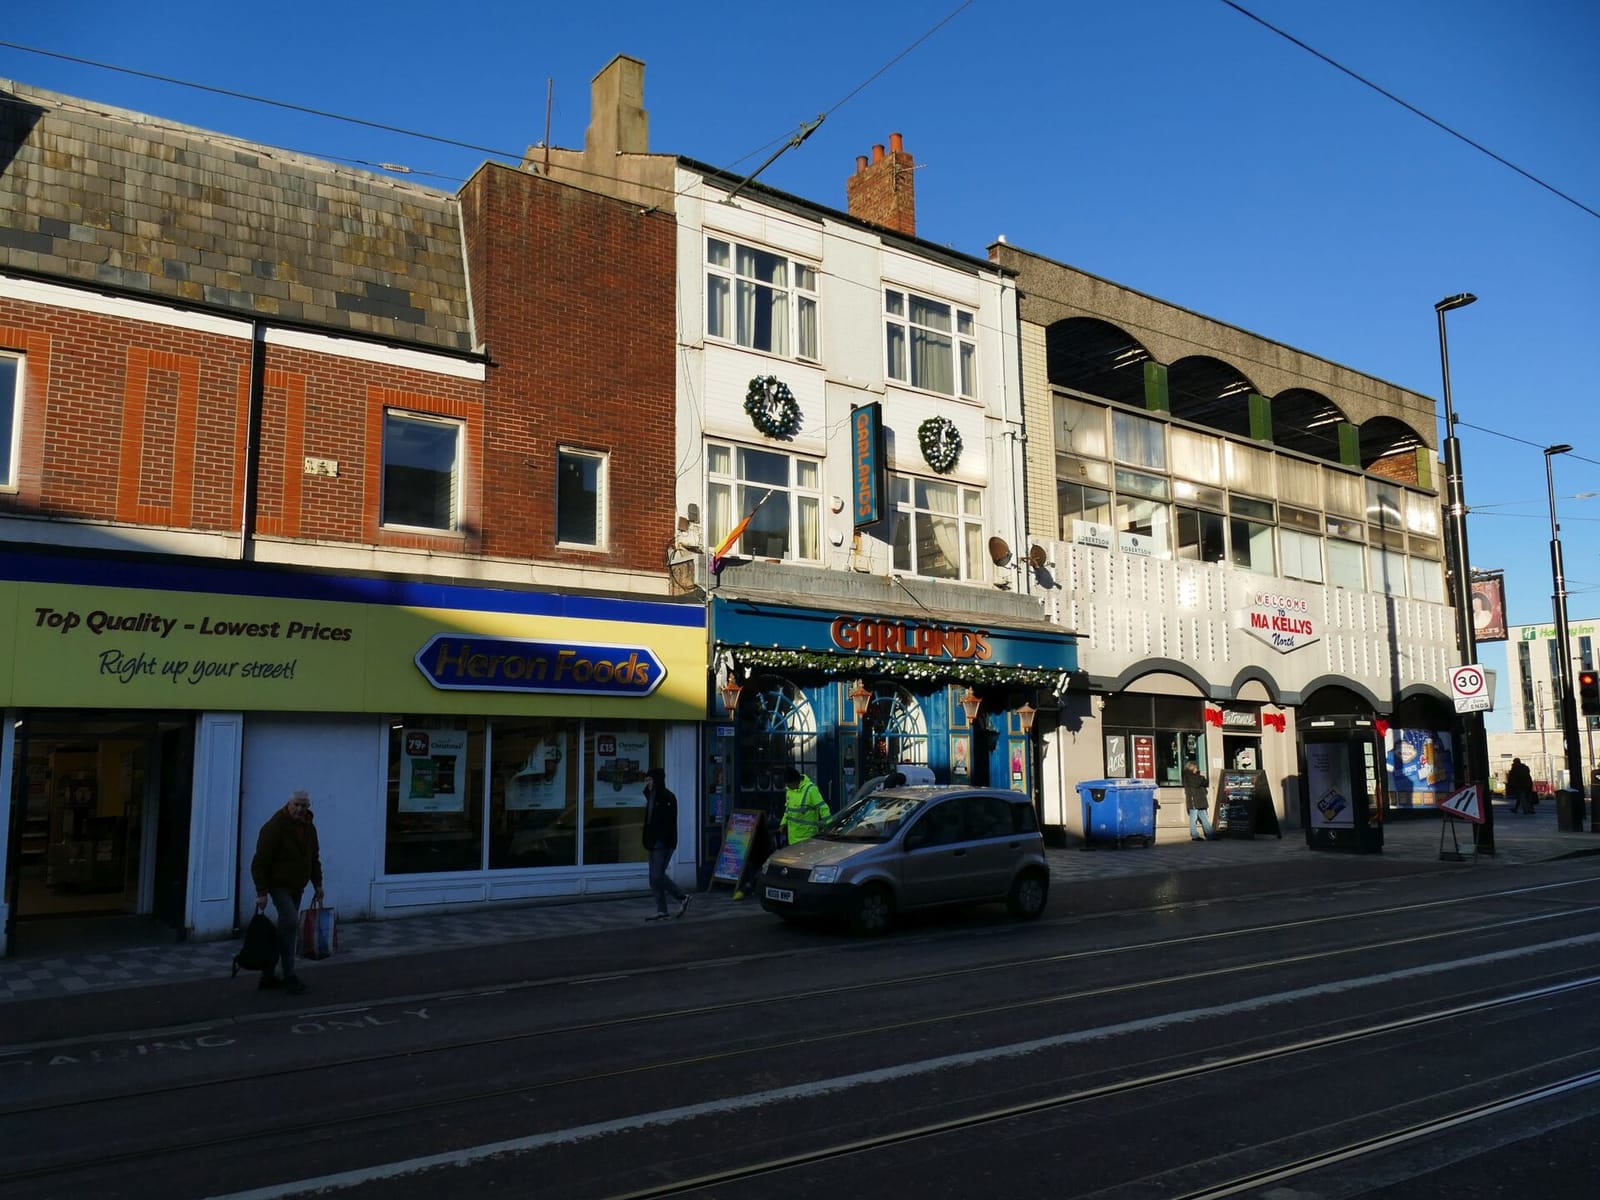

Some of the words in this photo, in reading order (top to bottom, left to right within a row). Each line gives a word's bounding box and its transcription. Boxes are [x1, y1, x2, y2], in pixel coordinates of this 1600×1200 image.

[857, 413, 871, 516] GARLANDS
[1256, 592, 1307, 611] WELCOME
[1278, 609, 1286, 617] TO
[35, 608, 80, 634] Top
[86, 610, 177, 638] Quality
[200, 617, 280, 637] Lowest
[287, 622, 352, 641] Prices
[830, 615, 992, 660] GARLANDS
[1251, 612, 1269, 629] MA
[1272, 616, 1312, 635] KELLYS
[1272, 633, 1294, 646] North
[99, 650, 156, 684] Right
[162, 662, 187, 684] up
[187, 661, 240, 684] your
[241, 659, 297, 680] street!
[434, 643, 547, 681] Heron
[553, 649, 650, 685] Foods
[1457, 674, 1479, 688] 30
